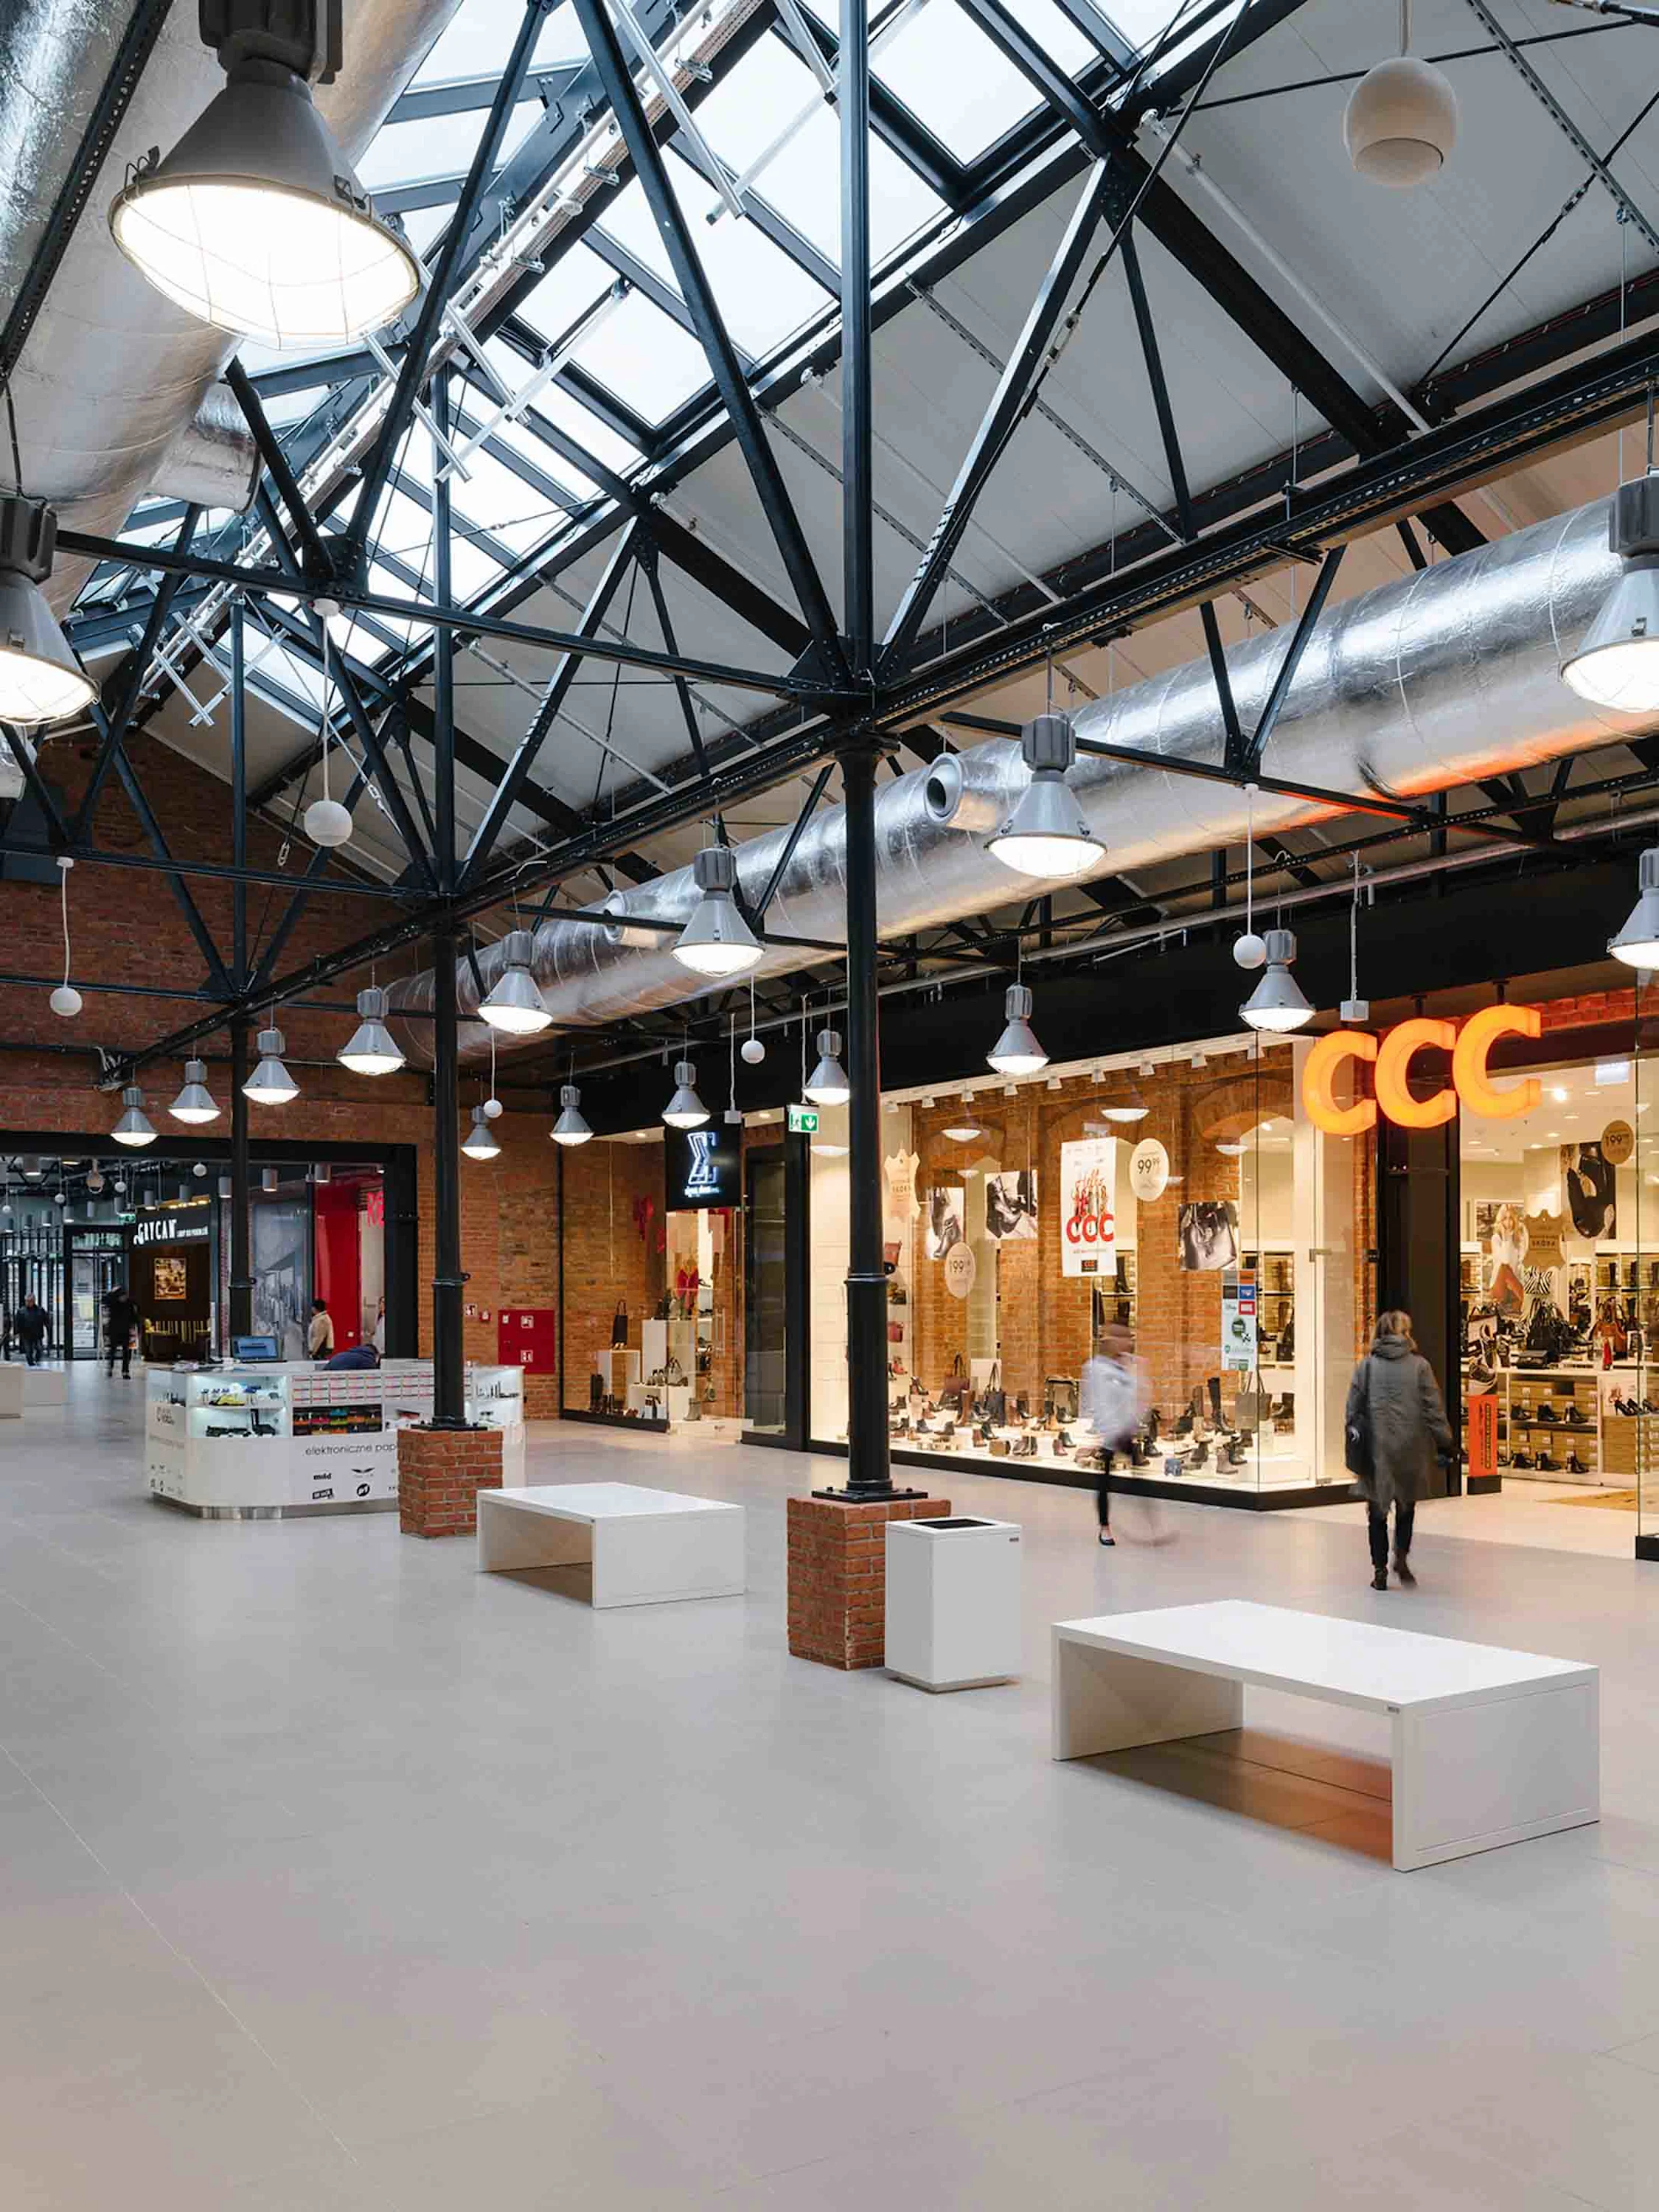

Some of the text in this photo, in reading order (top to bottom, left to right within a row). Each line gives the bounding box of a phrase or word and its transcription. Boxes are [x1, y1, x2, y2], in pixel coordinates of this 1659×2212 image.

[1302, 1004, 1542, 1135] CCC
[1066, 1213, 1114, 1244] CCC
[305, 1446, 372, 1455] elektroniczne
